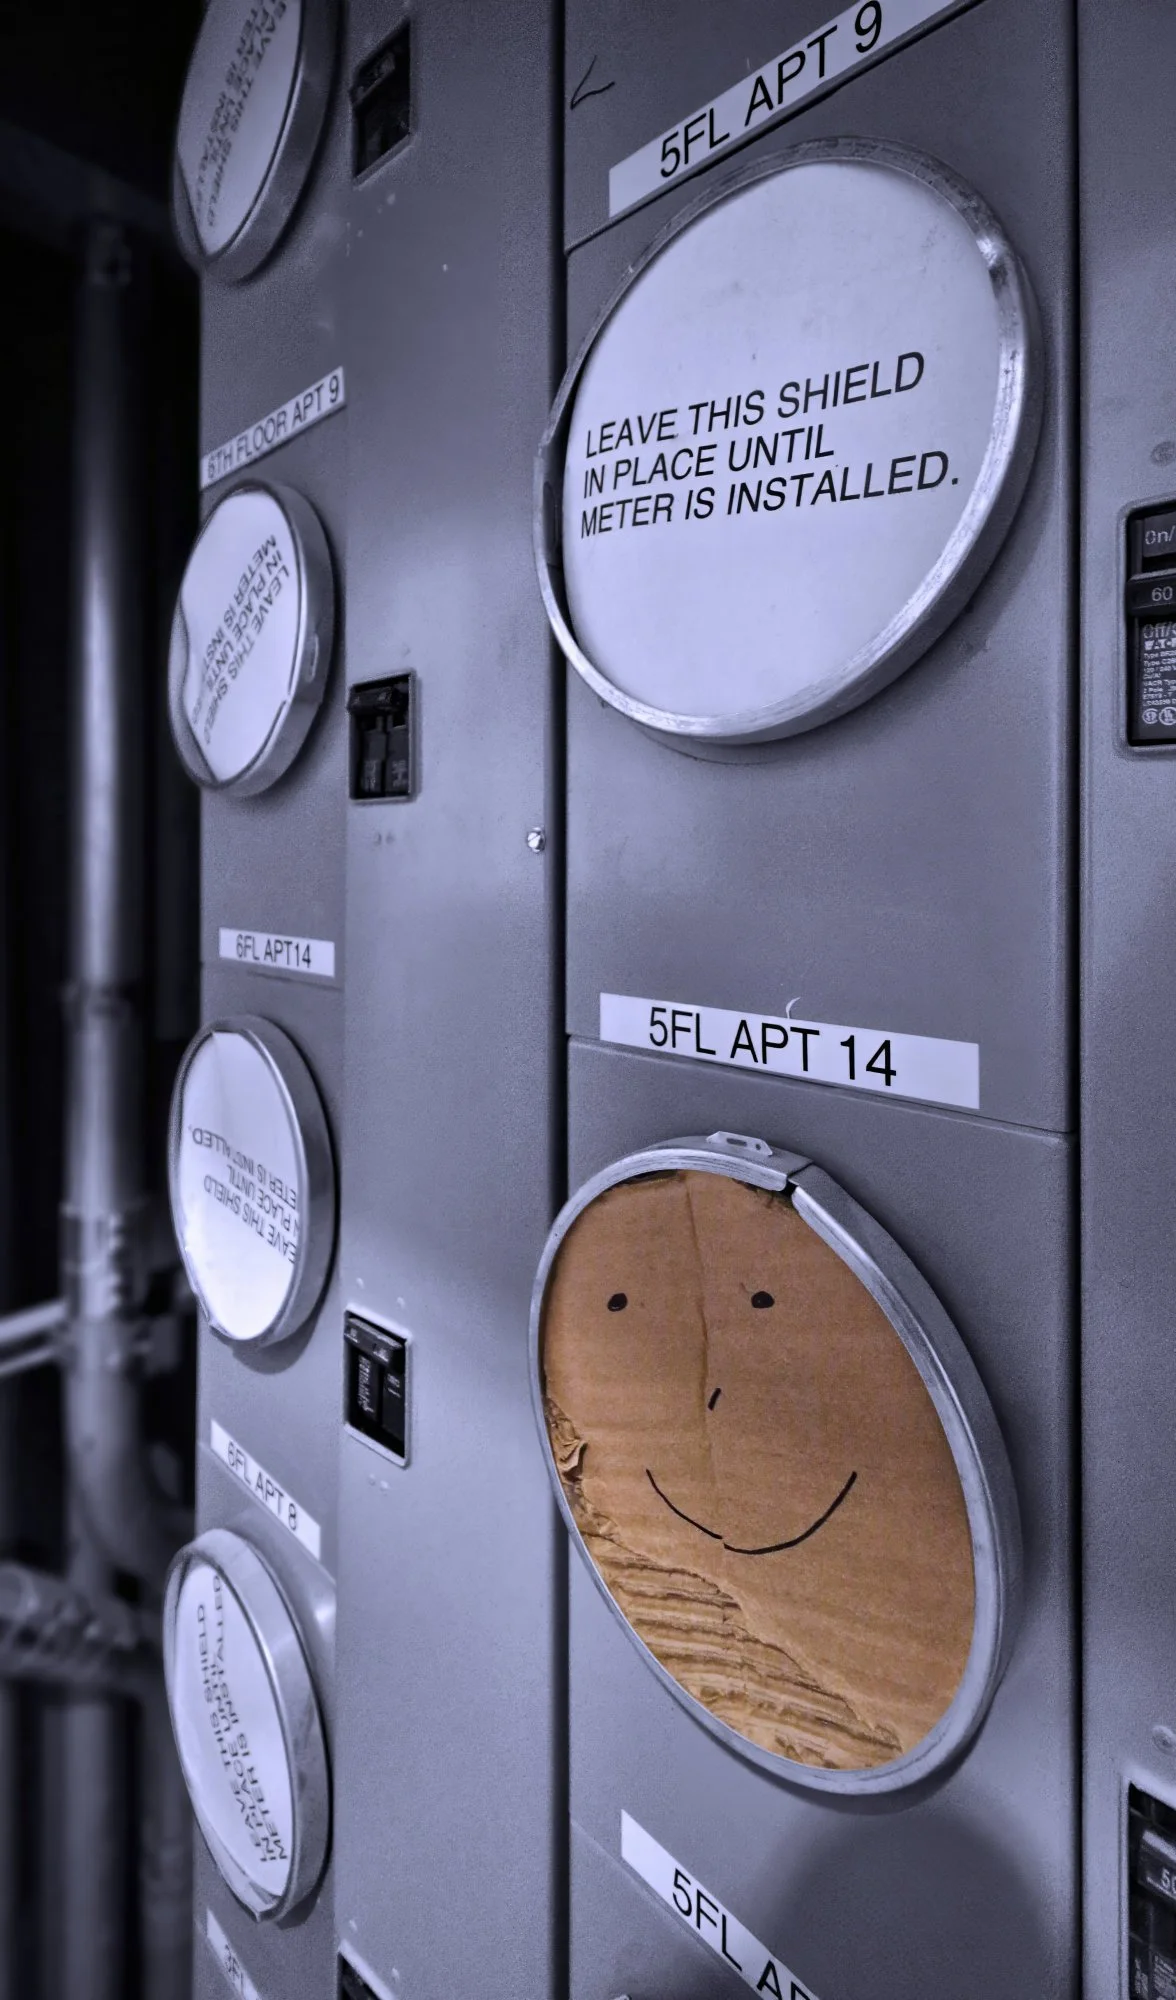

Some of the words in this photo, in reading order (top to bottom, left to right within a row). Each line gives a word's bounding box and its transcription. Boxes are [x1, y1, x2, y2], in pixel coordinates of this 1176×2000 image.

[660, 108, 731, 179] 5FL
[744, 26, 839, 127] APT
[854, 0, 883, 53] 9
[236, 410, 288, 462] FLOOR
[291, 383, 324, 429] APT
[328, 374, 340, 404] 9
[586, 408, 679, 459] LEAVE
[687, 389, 766, 436] THIS
[777, 351, 926, 419] SHIELD
[580, 492, 675, 539] METER
[684, 486, 715, 521] IS
[726, 450, 959, 516] INSTALLED.
[583, 464, 606, 499] IN
[612, 443, 718, 490] PLACE
[727, 423, 835, 473] UNTIL
[233, 534, 277, 607] METER
[265, 549, 283, 577] IN
[1151, 586, 1173, 602] 60
[232, 572, 267, 642] PLACE
[250, 564, 290, 636] LEAVE
[228, 634, 256, 681] THIS
[236, 933, 260, 960] 6FL
[649, 1006, 717, 1057] 5FL
[730, 1019, 820, 1073] APT
[840, 1033, 898, 1087] 14
[203, 1174, 242, 1215] SHIELD
[226, 1163, 257, 1202] UNTIL
[256, 1188, 292, 1233] PLACE
[257, 1163, 268, 1187] IS
[242, 1202, 265, 1239] THIS
[227, 1441, 252, 1487] 6FL
[254, 1471, 285, 1517] APT
[287, 1502, 298, 1532] 8
[236, 1732, 250, 1757] IS
[228, 1740, 264, 1828] PLACE
[246, 1765, 288, 1860] METER
[229, 1779, 267, 1862] LEAVE
[260, 1836, 278, 1862] IN
[672, 1868, 743, 1972] 5FL
